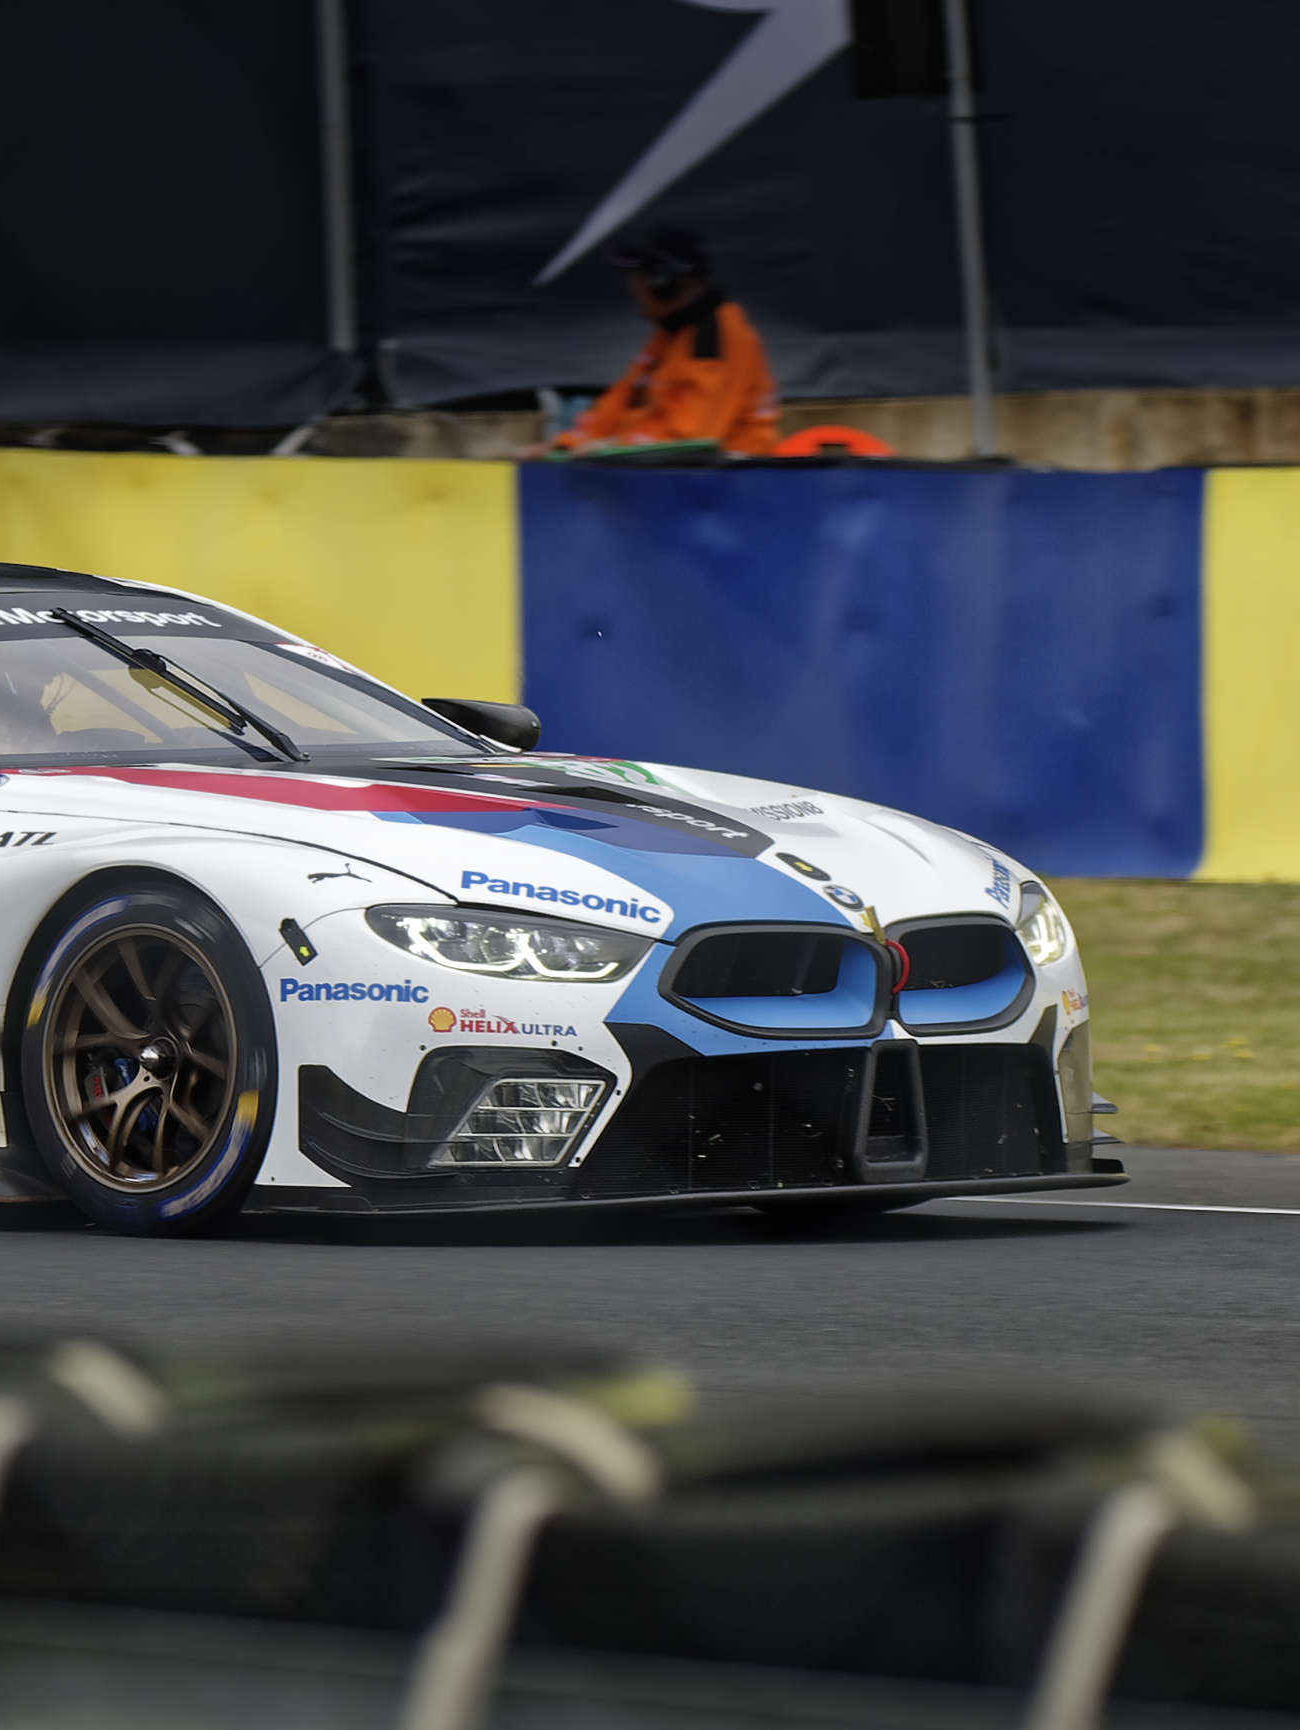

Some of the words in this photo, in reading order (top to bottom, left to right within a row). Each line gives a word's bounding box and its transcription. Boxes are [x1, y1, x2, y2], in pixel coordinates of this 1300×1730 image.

[460, 870, 662, 925] Panasonic
[279, 977, 430, 1003] Panasonic
[460, 1009, 486, 1019] Shell
[460, 1016, 520, 1034] HELIX
[521, 1023, 578, 1037] ULTRA
